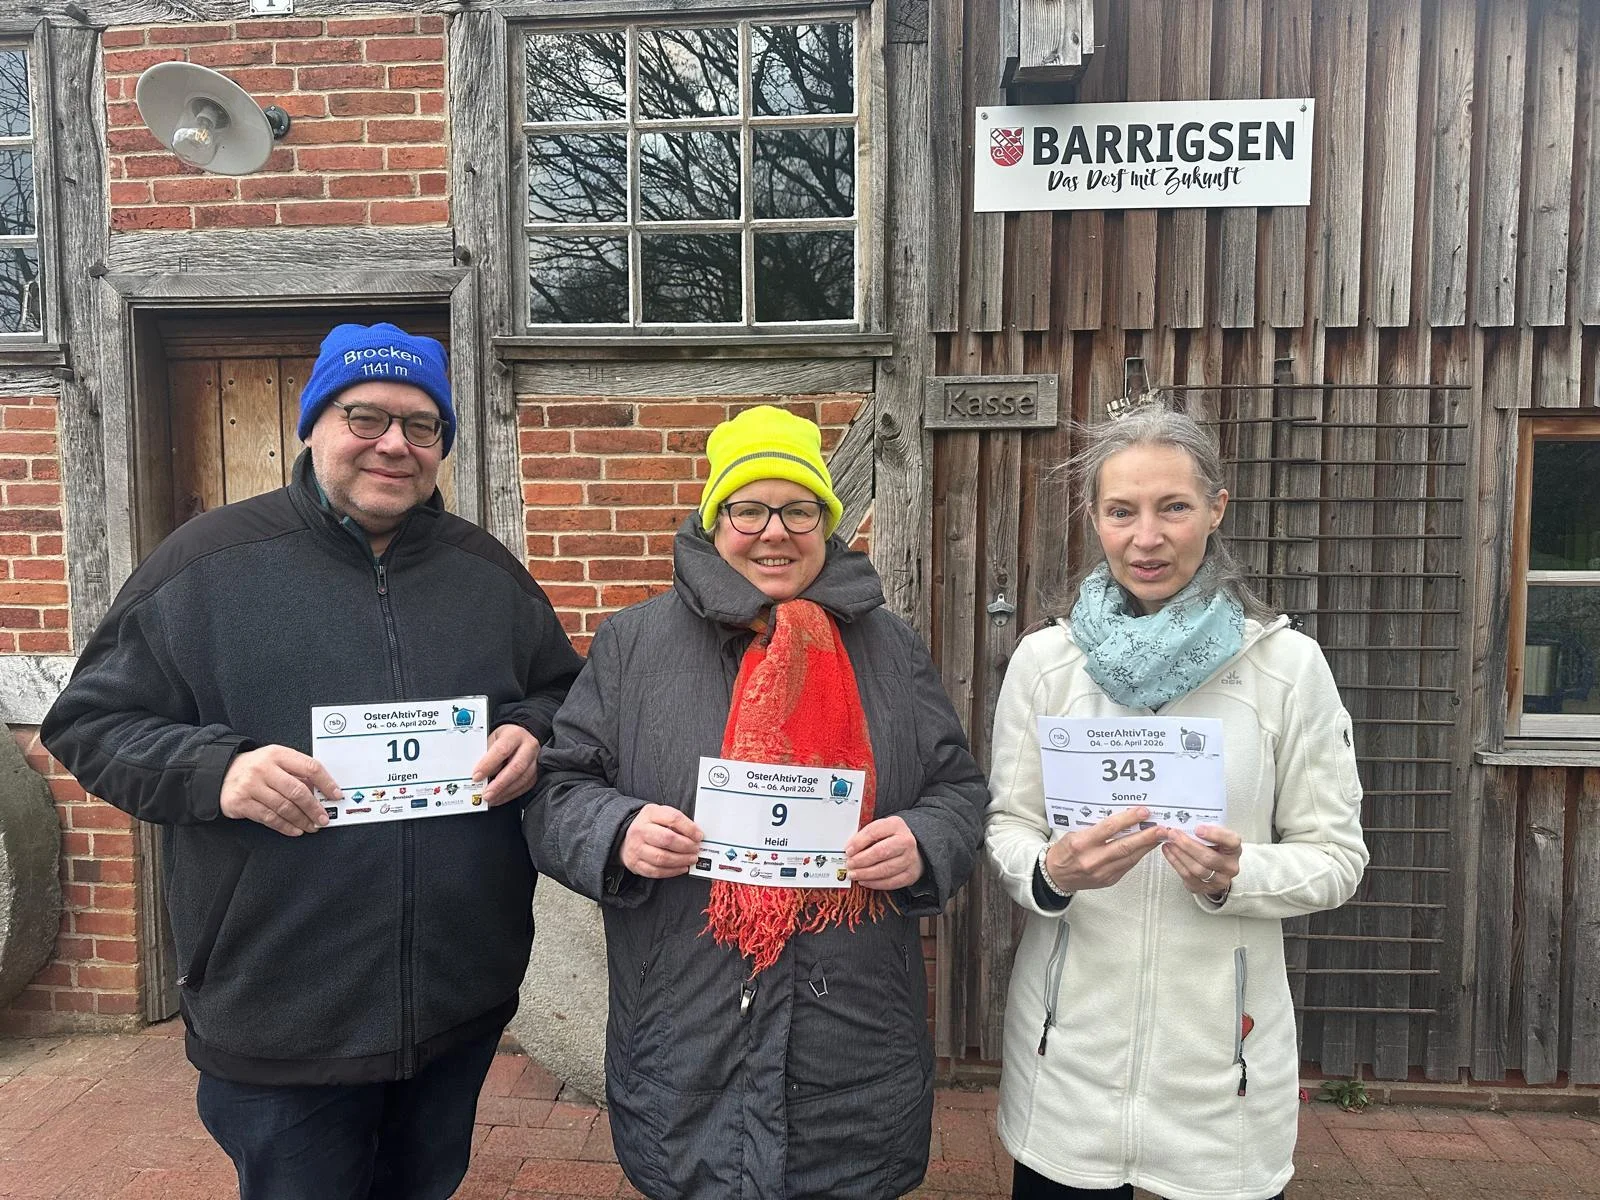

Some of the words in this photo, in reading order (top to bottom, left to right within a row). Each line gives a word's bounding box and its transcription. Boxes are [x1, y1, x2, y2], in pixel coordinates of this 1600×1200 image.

[1033, 121, 1295, 166] BARRIGSEN
[1048, 170, 1079, 192] Das
[1087, 168, 1129, 193] Dorf
[1131, 168, 1162, 190] mit
[1164, 165, 1245, 195] Zukunft
[344, 345, 422, 366] Brocken
[361, 362, 389, 376] 1141
[394, 365, 408, 376] m
[947, 388, 1036, 417] Kasse
[364, 709, 440, 721] OsterAktivTage
[366, 722, 380, 730] 04.
[386, 721, 399, 729] 06.
[400, 720, 417, 729] April
[418, 719, 437, 727] 2026
[1086, 728, 1166, 739] OsterAktivTage
[1110, 739, 1121, 747] 06.
[1124, 739, 1142, 747] April
[1143, 739, 1164, 747] 2026
[386, 738, 421, 763] 10
[1101, 758, 1156, 782] 343
[387, 773, 418, 782] Jürgen
[746, 770, 819, 785] OsterAktivTage
[767, 783, 779, 791] 06.
[780, 784, 797, 793] April
[797, 785, 815, 793] 2026
[1111, 792, 1148, 801] Sonne7
[771, 803, 788, 827] 9
[764, 837, 788, 847] Heidi
